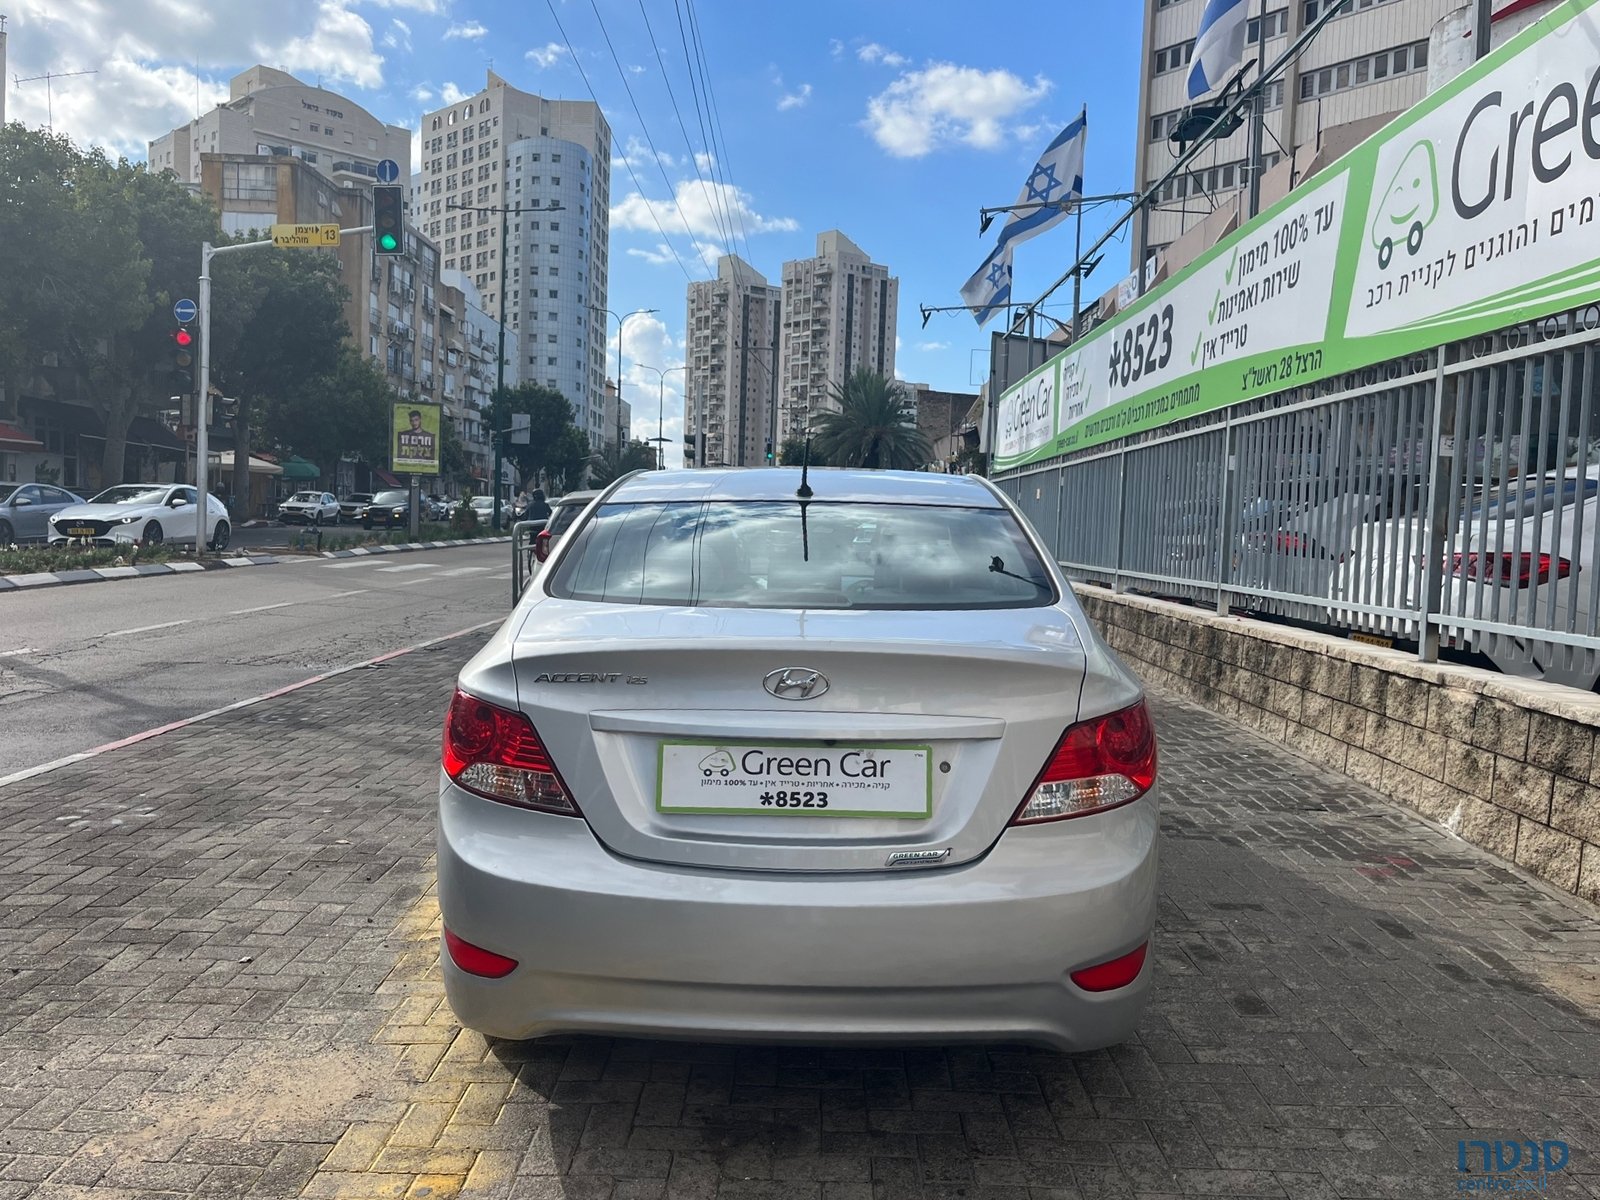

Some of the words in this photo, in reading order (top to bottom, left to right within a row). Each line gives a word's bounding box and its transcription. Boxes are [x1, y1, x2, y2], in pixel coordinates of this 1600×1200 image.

[1314, 201, 1335, 236] עד
[1550, 193, 1600, 236] מים
[280, 234, 309, 244] מוהליבר
[294, 225, 314, 235] ויצמן
[325, 229, 336, 240] 13
[1273, 213, 1309, 260] 100%
[1464, 218, 1538, 270] והוגנים
[1236, 240, 1269, 287] מימון
[1399, 249, 1457, 296] לקניית
[1260, 260, 1301, 302] שירות
[1217, 285, 1259, 325] ואמינות
[1366, 281, 1392, 308] רכב
[1201, 335, 1216, 371] אין
[1220, 323, 1248, 357] טרייד
[1279, 355, 1293, 380] 28
[1295, 349, 1323, 375] הרצל
[1242, 361, 1277, 391] ראשל"צ
[1013, 393, 1036, 431] Green
[1036, 378, 1053, 421] Car
[1145, 395, 1169, 420] במכירת
[1169, 383, 1200, 411] מתמחים
[411, 435, 432, 446] חרם
[534, 672, 622, 683] ACCENT
[741, 750, 831, 777] Green
[839, 752, 891, 778] Car
[701, 778, 722, 787] מימון
[724, 778, 747, 787] 100%
[748, 778, 759, 787] עד
[764, 779, 777, 788] אין
[779, 779, 800, 788] טרייד
[806, 780, 835, 789] אחריות
[841, 780, 866, 789] מכירה
[872, 781, 891, 790] קניה
